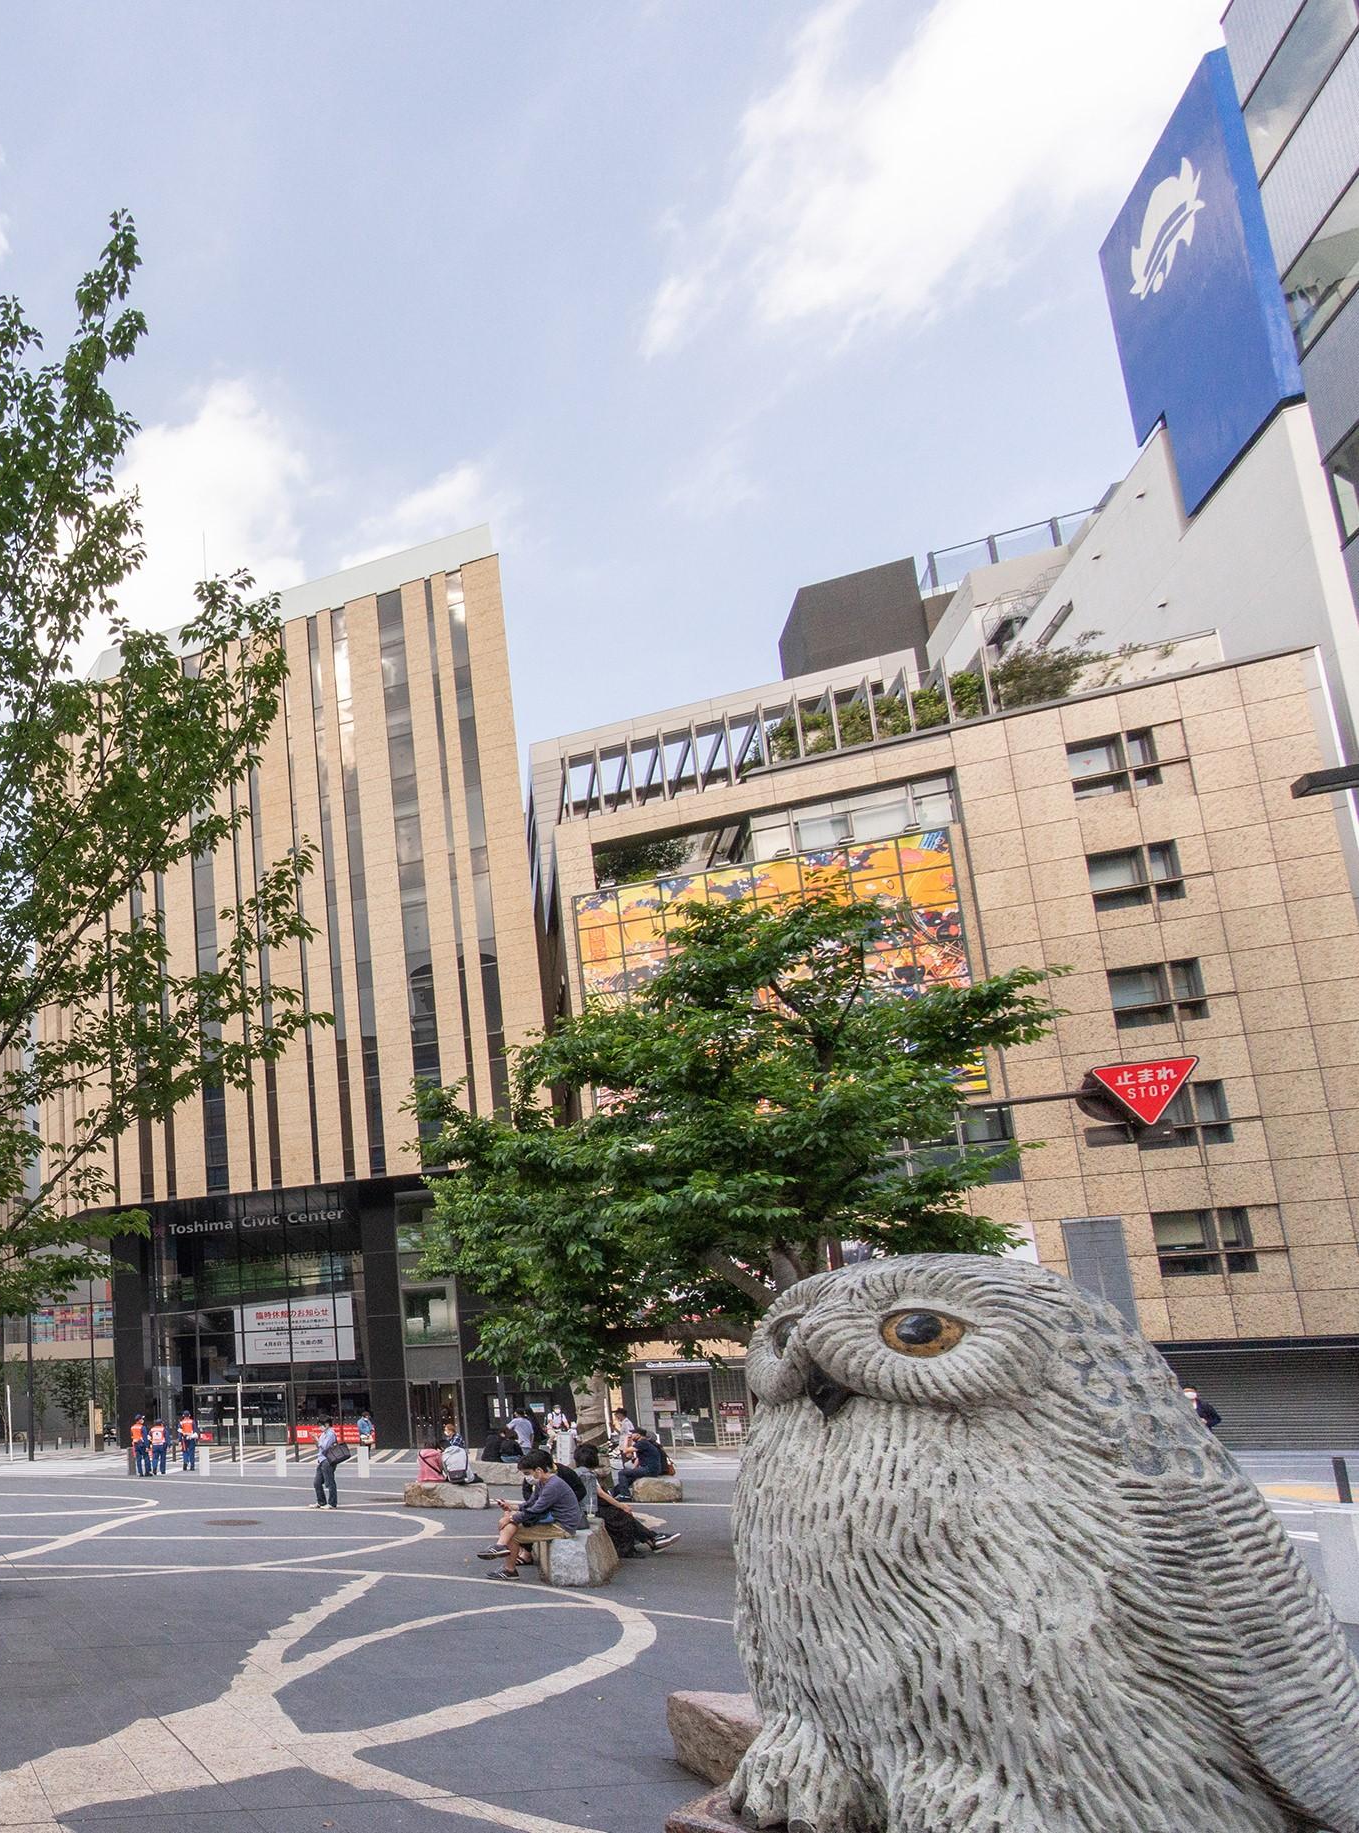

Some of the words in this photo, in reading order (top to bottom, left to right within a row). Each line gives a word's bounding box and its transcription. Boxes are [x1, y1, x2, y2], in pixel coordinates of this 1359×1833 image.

[1115, 1066, 1178, 1086] 止まれ
[1127, 1084, 1170, 1099] STOP
[169, 1219, 234, 1235] Toshima
[241, 1214, 280, 1228] Civic
[287, 1209, 344, 1224] Center
